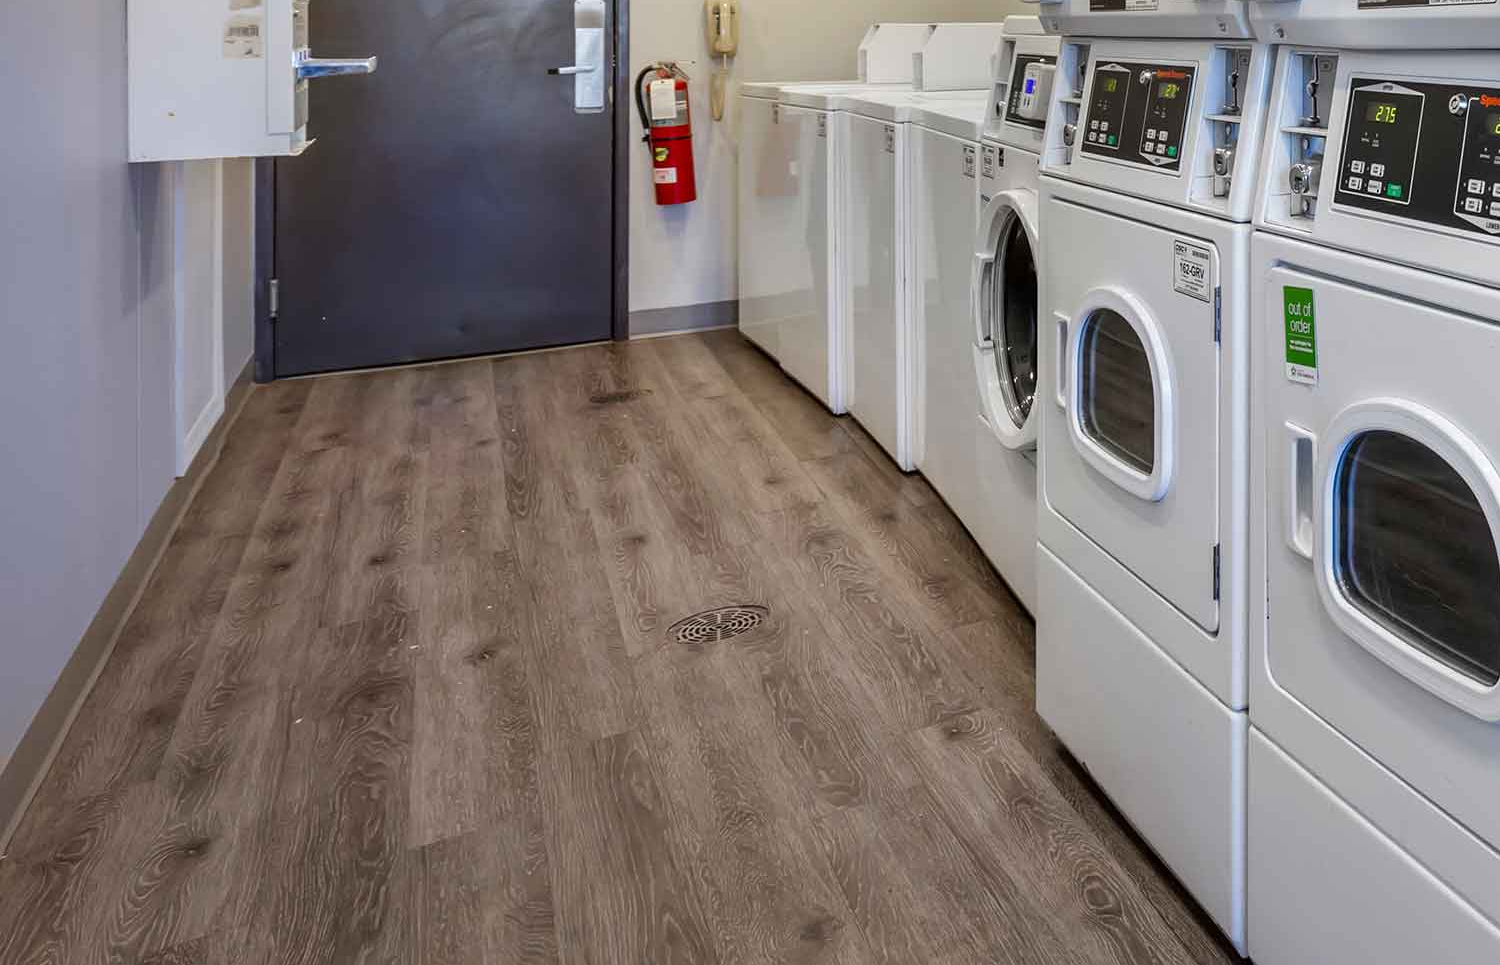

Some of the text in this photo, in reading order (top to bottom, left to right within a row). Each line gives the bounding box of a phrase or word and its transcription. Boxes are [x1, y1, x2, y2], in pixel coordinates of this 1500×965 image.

[1376, 106, 1396, 123] 275
[1288, 301, 1311, 316] out of
[1290, 318, 1310, 333] order
